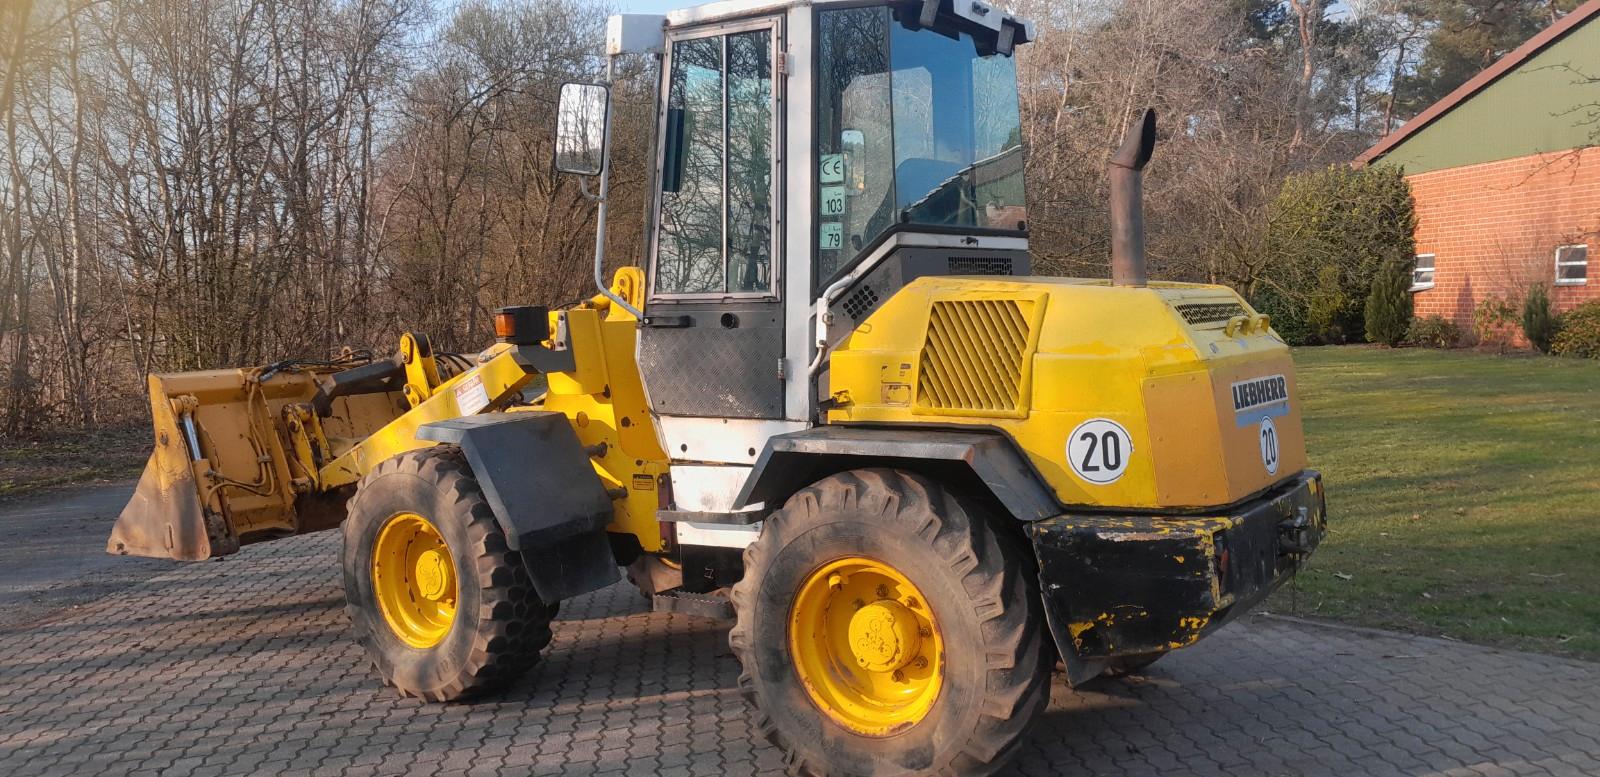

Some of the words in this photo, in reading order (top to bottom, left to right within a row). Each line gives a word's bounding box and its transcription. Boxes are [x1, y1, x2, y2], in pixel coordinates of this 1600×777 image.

[826, 199, 843, 213] 103
[828, 233, 840, 247] 79
[1232, 376, 1287, 410] LIEBHERR
[1080, 430, 1121, 472] 20
[1262, 427, 1276, 466] 20
